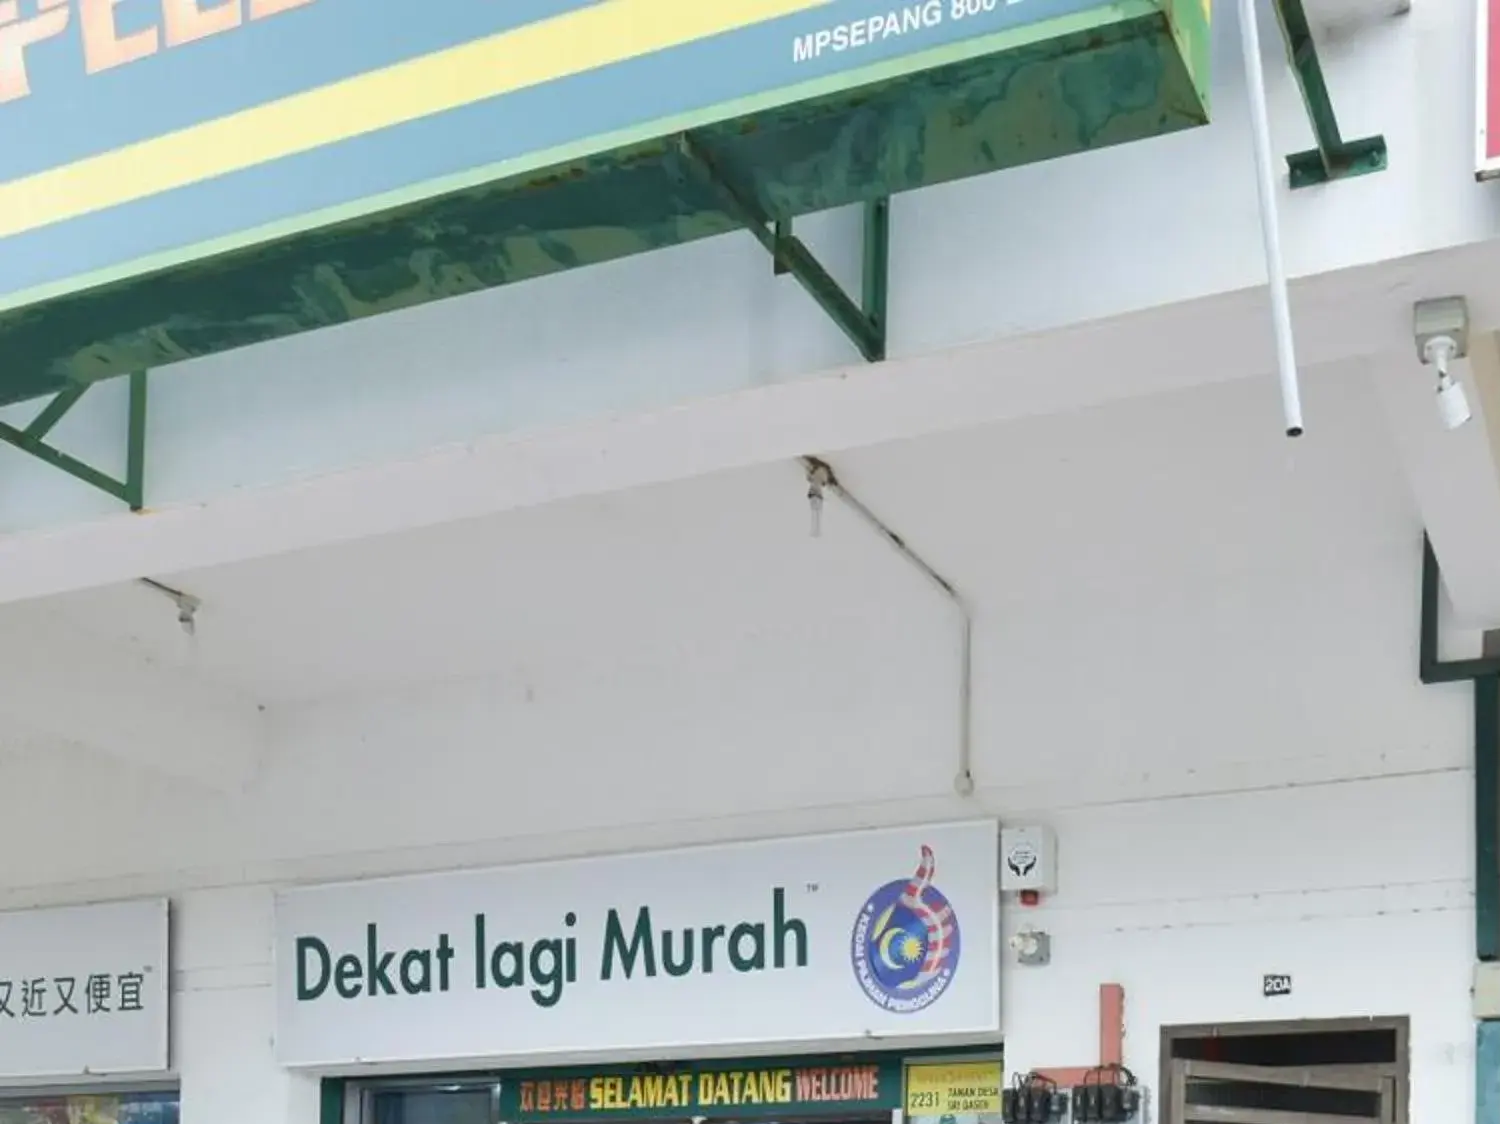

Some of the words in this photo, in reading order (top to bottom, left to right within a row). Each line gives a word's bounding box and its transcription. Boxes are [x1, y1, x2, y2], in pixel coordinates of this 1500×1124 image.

[793, 1, 942, 63] MPSEPANG
[296, 923, 454, 1001] Dekat
[475, 912, 577, 1007] lagi
[600, 887, 808, 980] Murah
[589, 1074, 692, 1110] SELAMAT
[698, 1068, 792, 1105] DATANG
[910, 1091, 939, 1108] 2231
